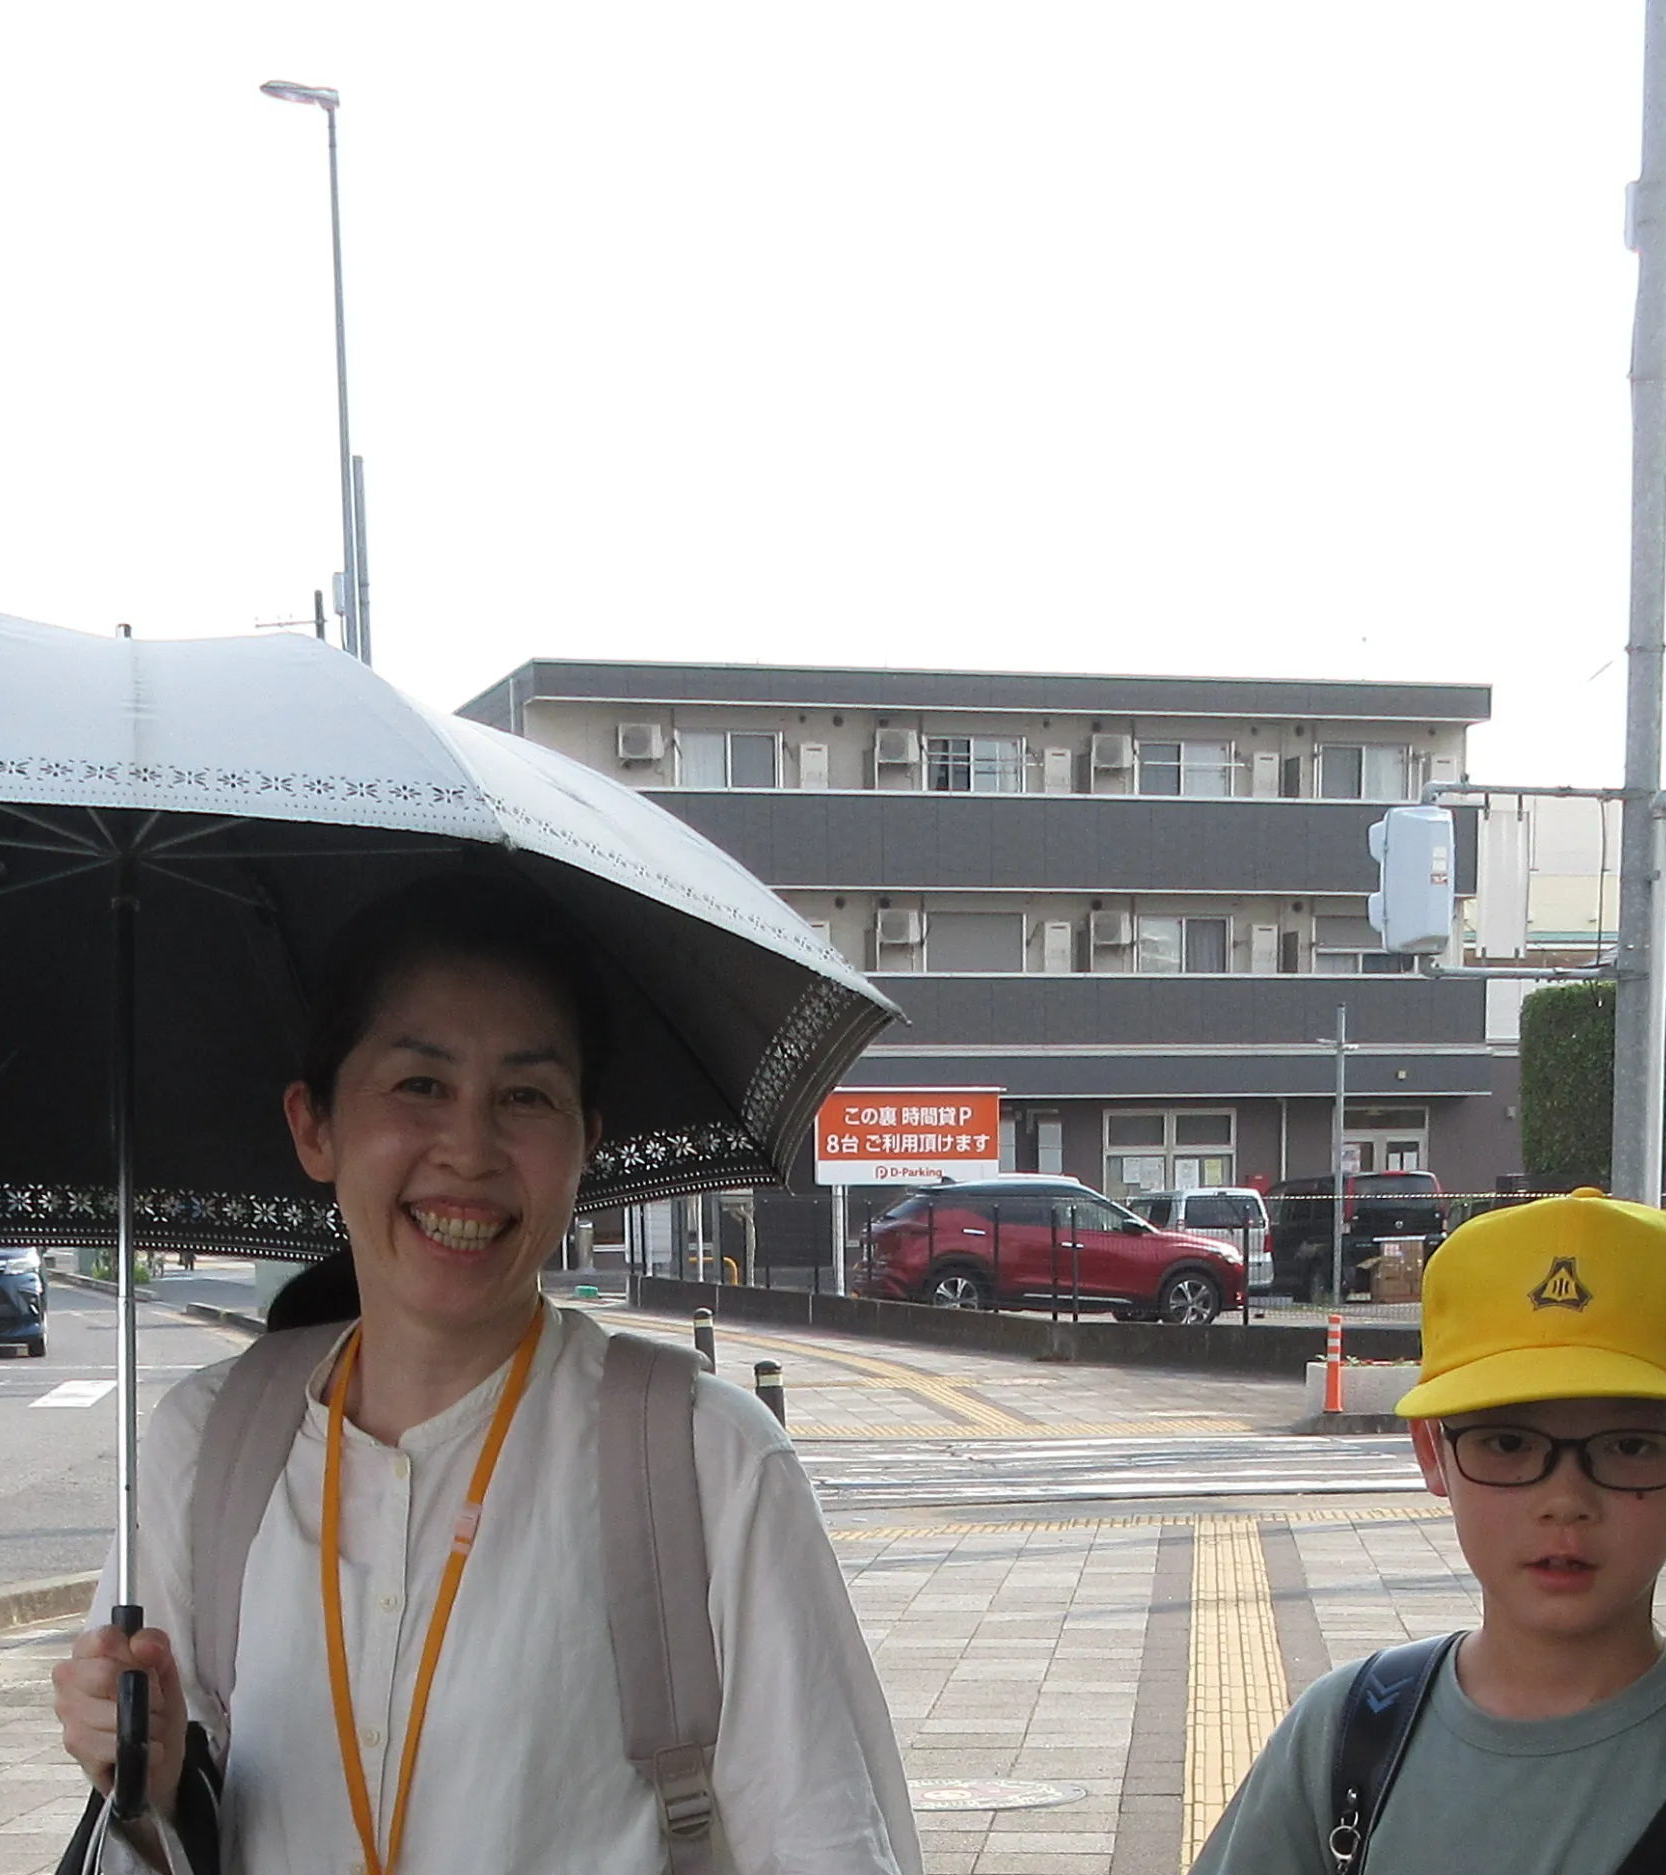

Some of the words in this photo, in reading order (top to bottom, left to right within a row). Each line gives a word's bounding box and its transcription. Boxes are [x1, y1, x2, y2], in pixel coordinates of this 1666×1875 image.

[844, 1107, 897, 1126] この裏
[826, 1134, 860, 1154] 8台
[865, 1134, 991, 1153] ご利用頂けます
[890, 1167, 943, 1179] D-Parking
